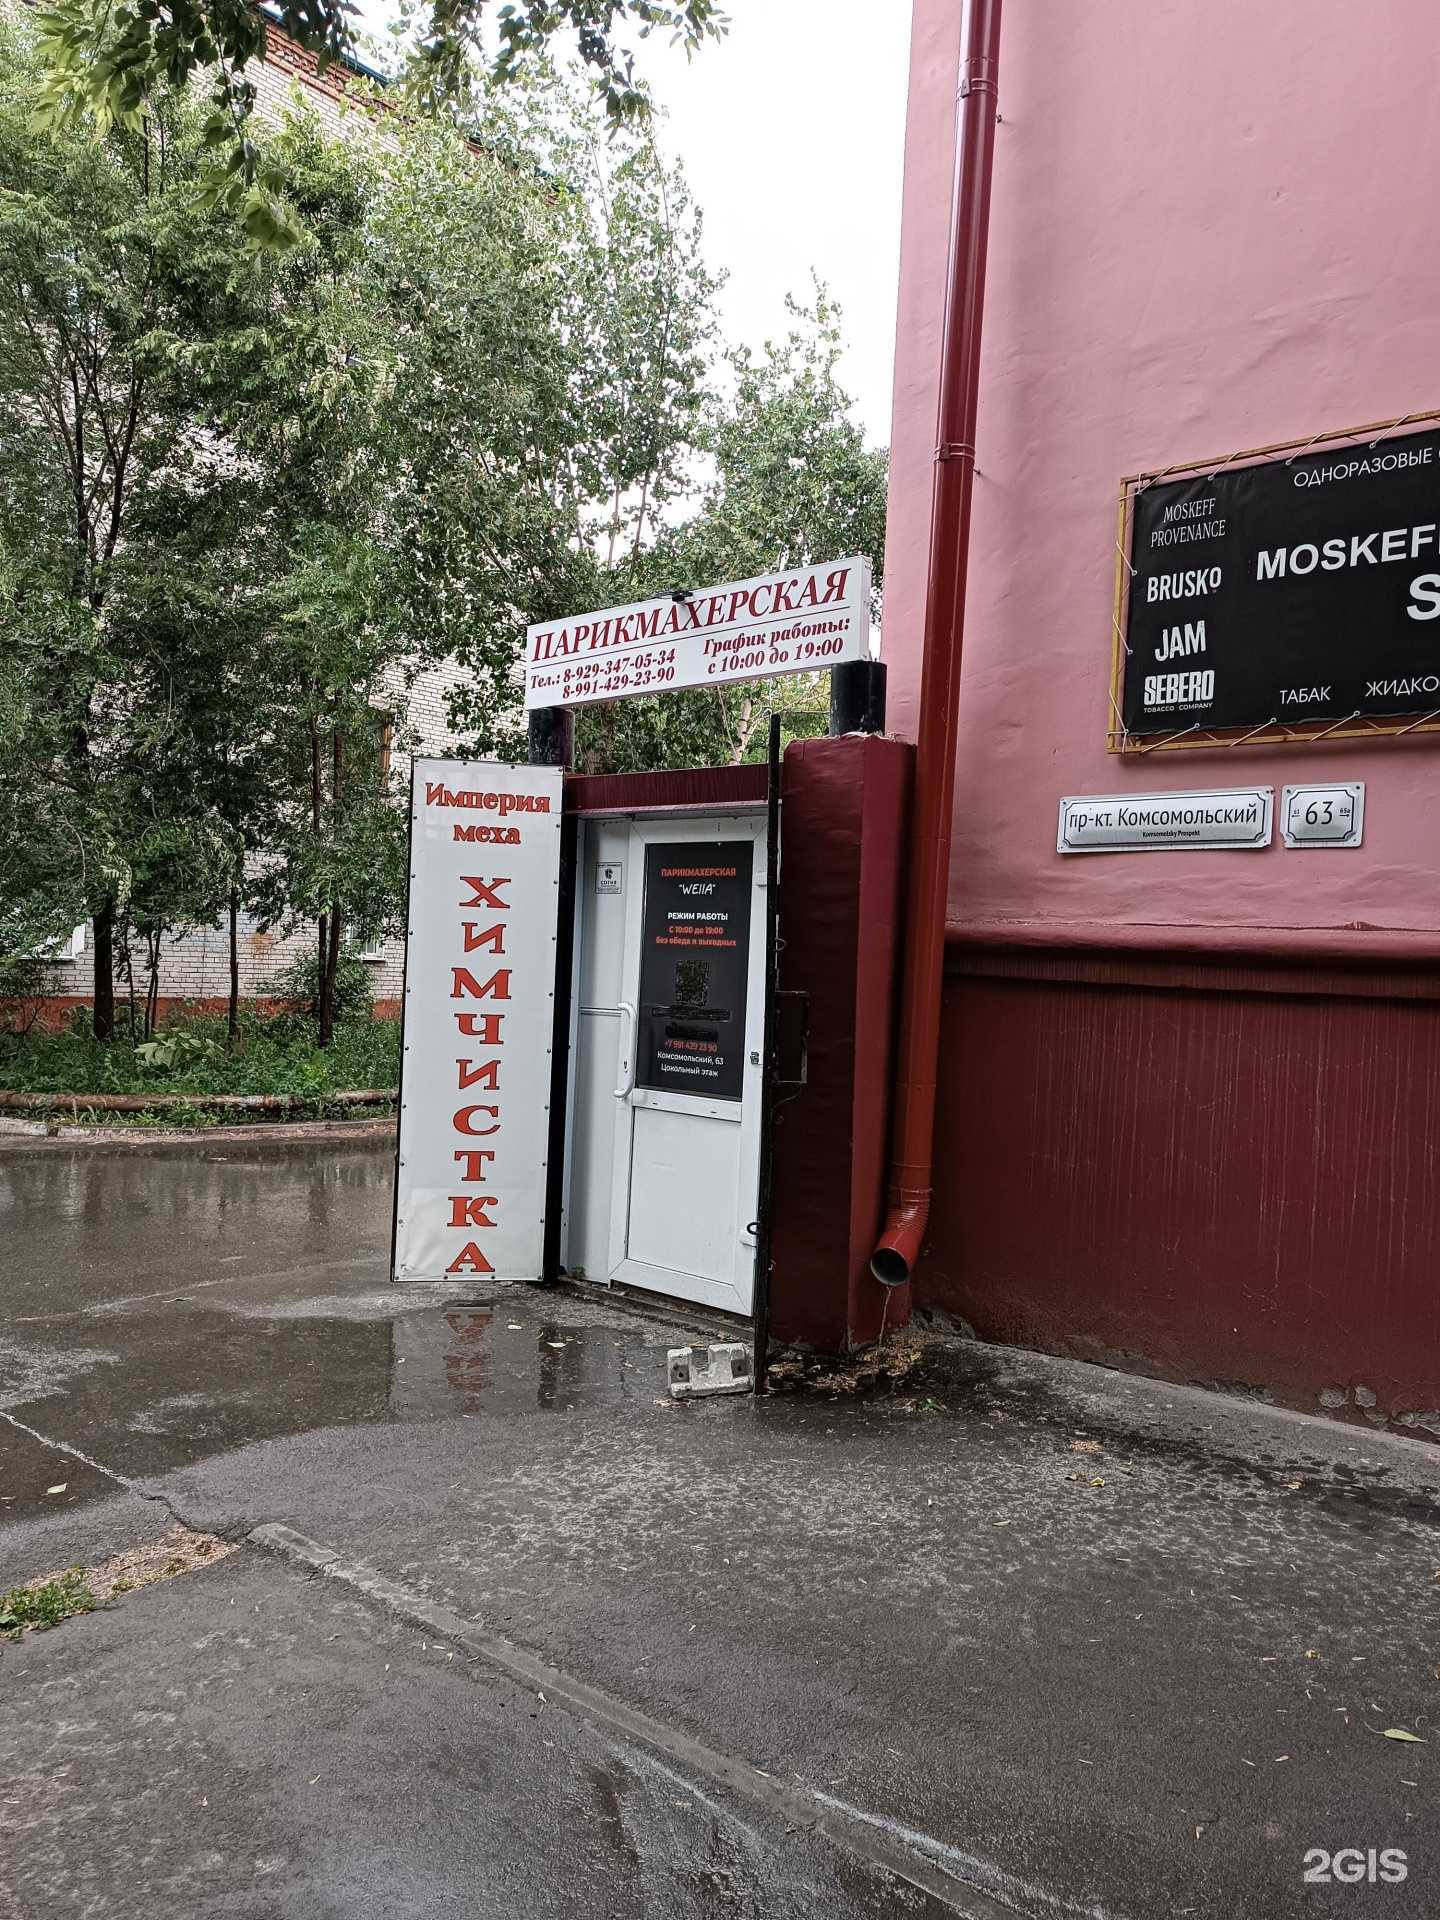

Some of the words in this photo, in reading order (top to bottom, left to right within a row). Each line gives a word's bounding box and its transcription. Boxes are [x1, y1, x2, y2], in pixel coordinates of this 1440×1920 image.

[1293, 447, 1433, 487] ОДНОРАЗОВЫЕ
[1163, 497, 1216, 523] MOSKEFF
[1151, 519, 1226, 548] PROVENANCE
[1256, 524, 1440, 581] MOSKEF
[1147, 566, 1222, 602] BRUSKO
[531, 568, 852, 662] ПАРИКМАХЕРСКАЯ
[703, 633, 766, 657] График
[769, 617, 850, 647] работы:
[1154, 620, 1207, 662] JAM
[530, 674, 561, 689] Тел.:
[563, 648, 676, 683] 8-929-347-05-34
[707, 663, 716, 675] с
[719, 651, 765, 673] 10:00
[769, 646, 790, 665] до
[794, 637, 844, 660] 19:00
[562, 667, 675, 699] 8-991-429-23-90
[1143, 670, 1215, 707] SEBERO
[1280, 686, 1331, 705] ТАБАК
[1365, 676, 1440, 697] ЖИДКО
[1144, 705, 1175, 713] TOBACCO
[1179, 702, 1213, 711] COMPANY
[425, 782, 550, 816] Империя
[1305, 801, 1333, 825] 63
[1069, 811, 1113, 830] пр-кт.
[1118, 803, 1258, 827] Комсомольский
[453, 824, 521, 845] меха
[661, 867, 737, 878] ПАРИКМАХЕРСКАЯ
[667, 912, 695, 920] РЕЖИМ
[696, 912, 728, 921] РАБОТЫ
[675, 926, 694, 934] 10:00
[705, 927, 725, 935] 19:00
[657, 1050, 714, 1065] Комсомольский,
[715, 1057, 724, 1065] 63
[661, 1063, 701, 1075] Цокольный
[701, 1068, 719, 1077] этаж
[445, 876, 513, 1273] ХИМЧИСТКА
